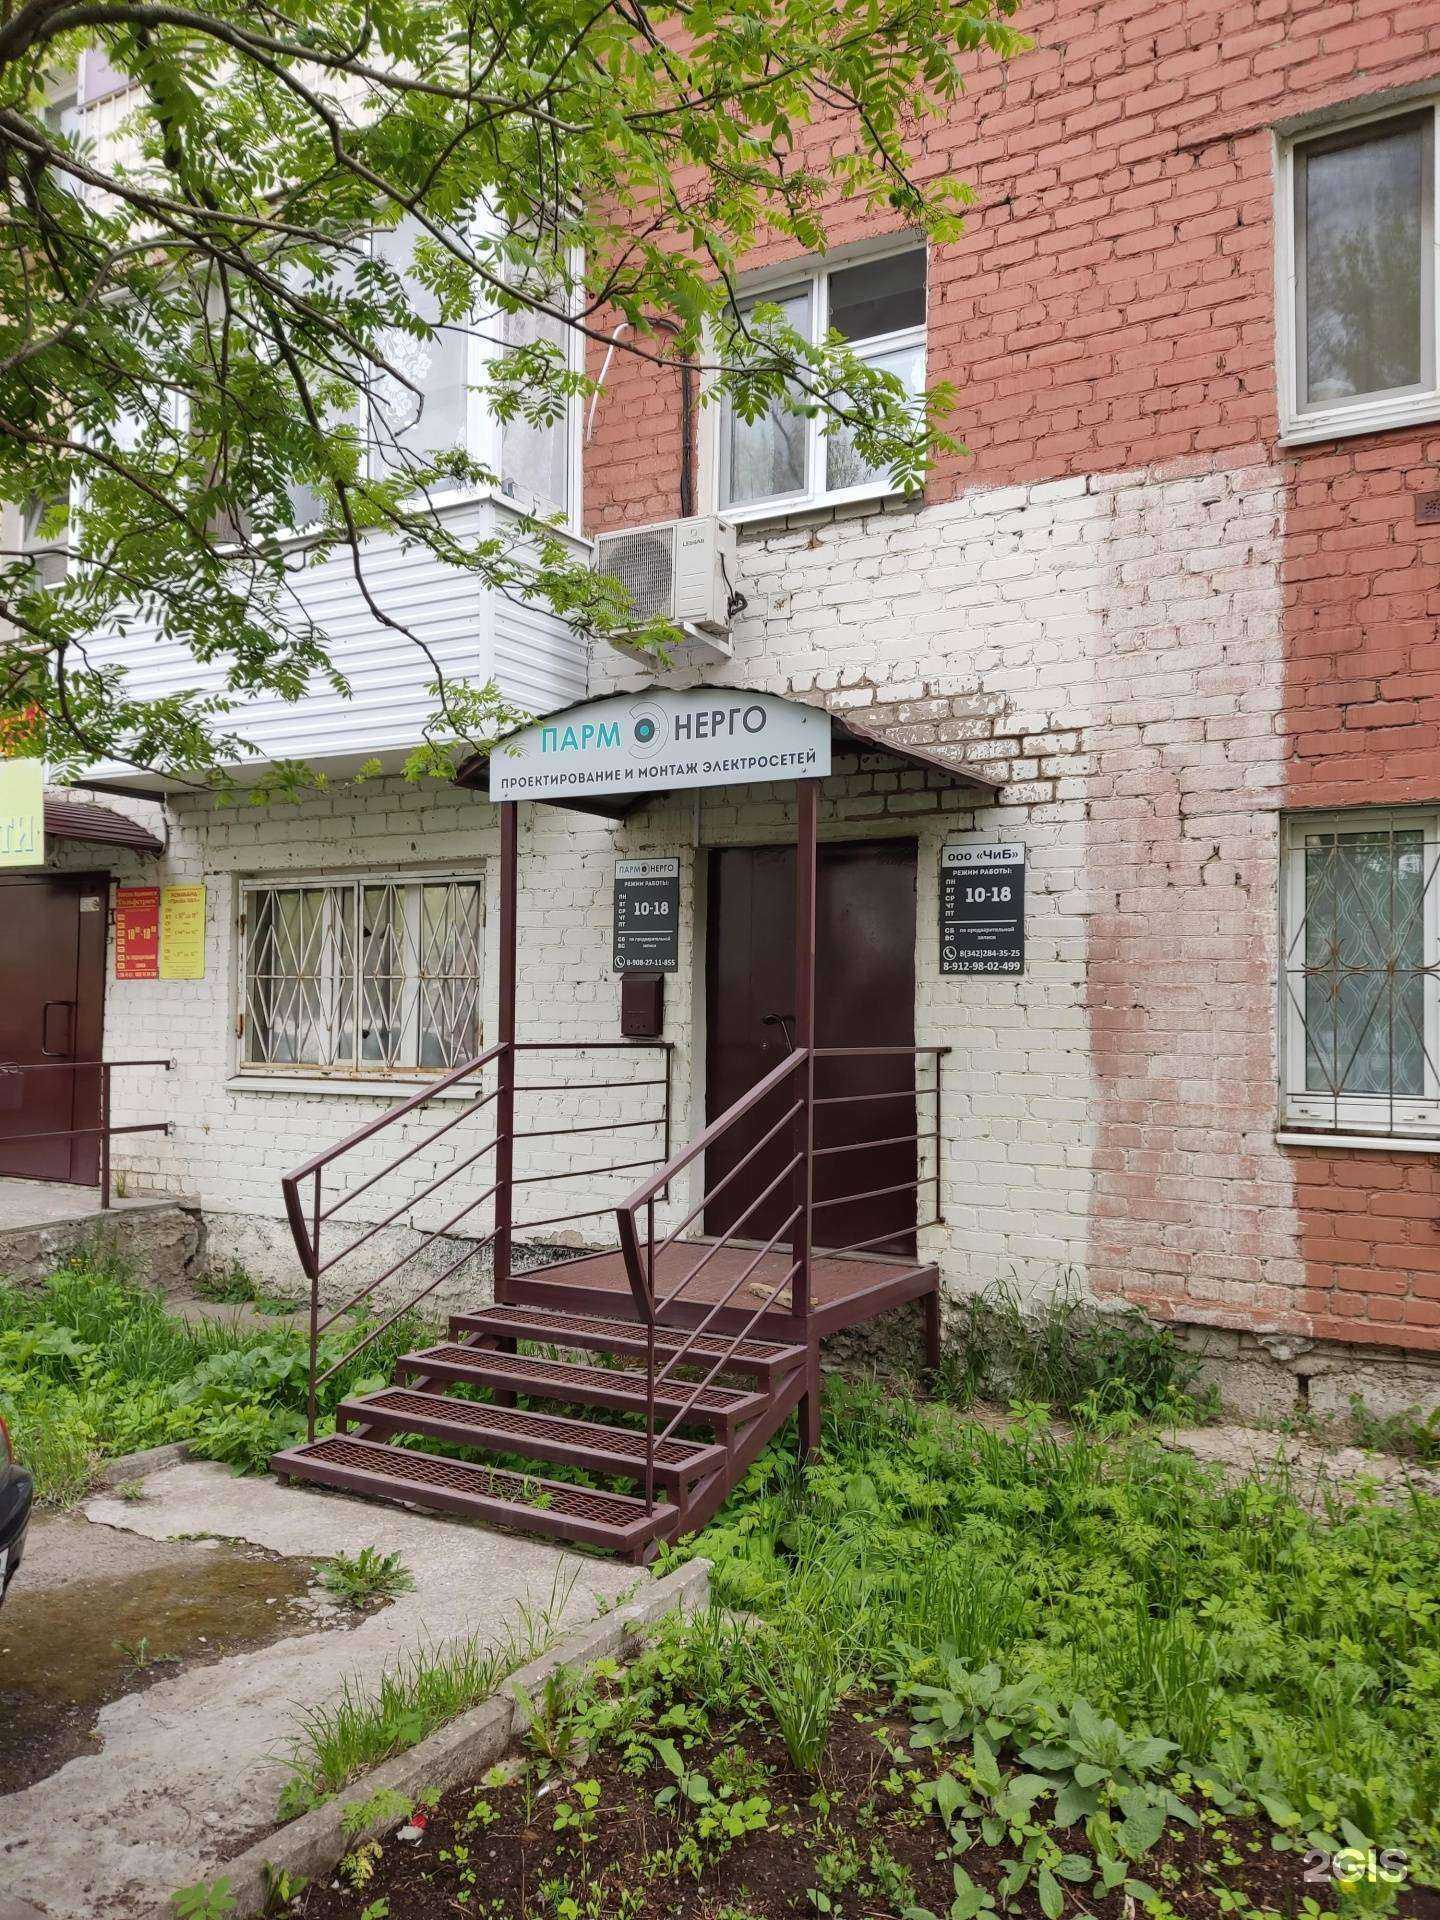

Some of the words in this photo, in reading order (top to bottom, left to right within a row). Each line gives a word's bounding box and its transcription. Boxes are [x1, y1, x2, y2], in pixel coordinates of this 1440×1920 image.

[540, 721, 621, 753] ПАРМ
[501, 768, 621, 789] ПРОЕКТИРОВАНИЕ
[624, 767, 634, 780] И
[638, 763, 699, 780] МОНТАЖ
[702, 747, 817, 774] ЭЛЕКТРОСЕТЕЙ
[952, 869, 979, 877] РЕЖИМ
[965, 886, 1012, 903] 10-18
[634, 901, 669, 916] 10-18
[943, 961, 1020, 971] 8-912-98-02-499
